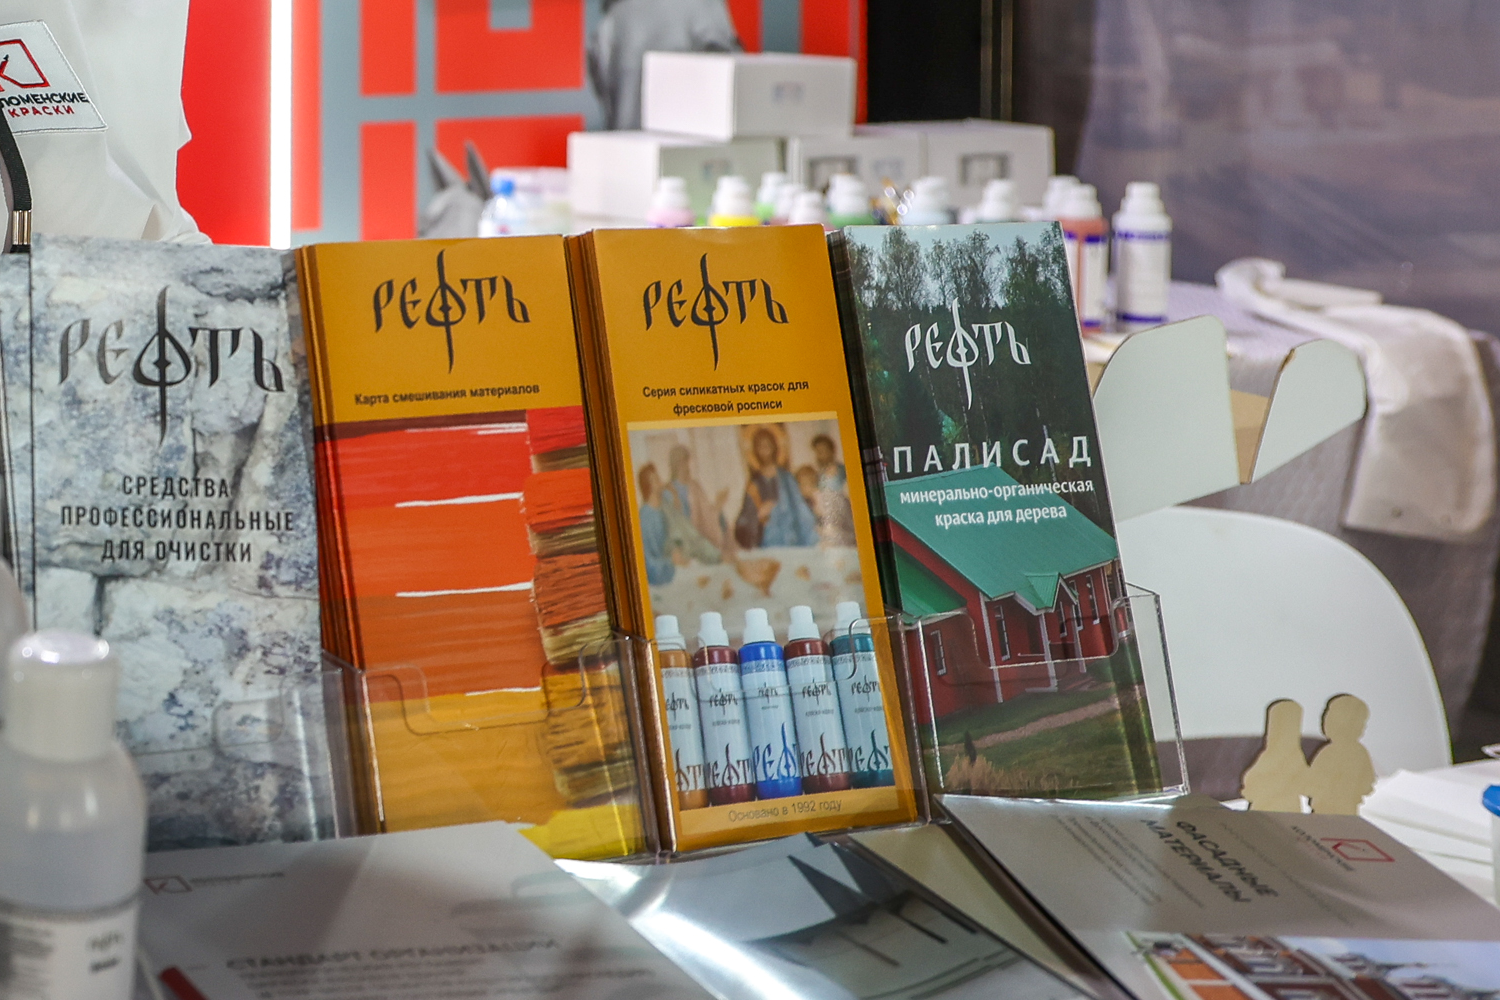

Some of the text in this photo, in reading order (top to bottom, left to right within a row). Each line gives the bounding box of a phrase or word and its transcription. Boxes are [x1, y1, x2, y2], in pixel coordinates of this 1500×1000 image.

[0, 92, 90, 107] ЛОМЕНСКИЕ
[8, 105, 75, 118] КРАСКИ
[354, 384, 540, 407] Карта смешивания материалов
[642, 380, 810, 399] Серия силикатных красок для
[673, 400, 783, 417] фресковой росписи
[893, 435, 1092, 473] ПАЛИСАД
[123, 475, 230, 499] СРЕДСТВА
[900, 478, 1094, 504] минерально-органическая
[60, 505, 294, 531] ПРОФЕССИОНАЛЬНЫЕ
[935, 504, 1067, 530] краска для дерева
[101, 540, 252, 562] ДЛЯ ОЧИСТКИ
[729, 799, 842, 822] Основано в 1992 году
